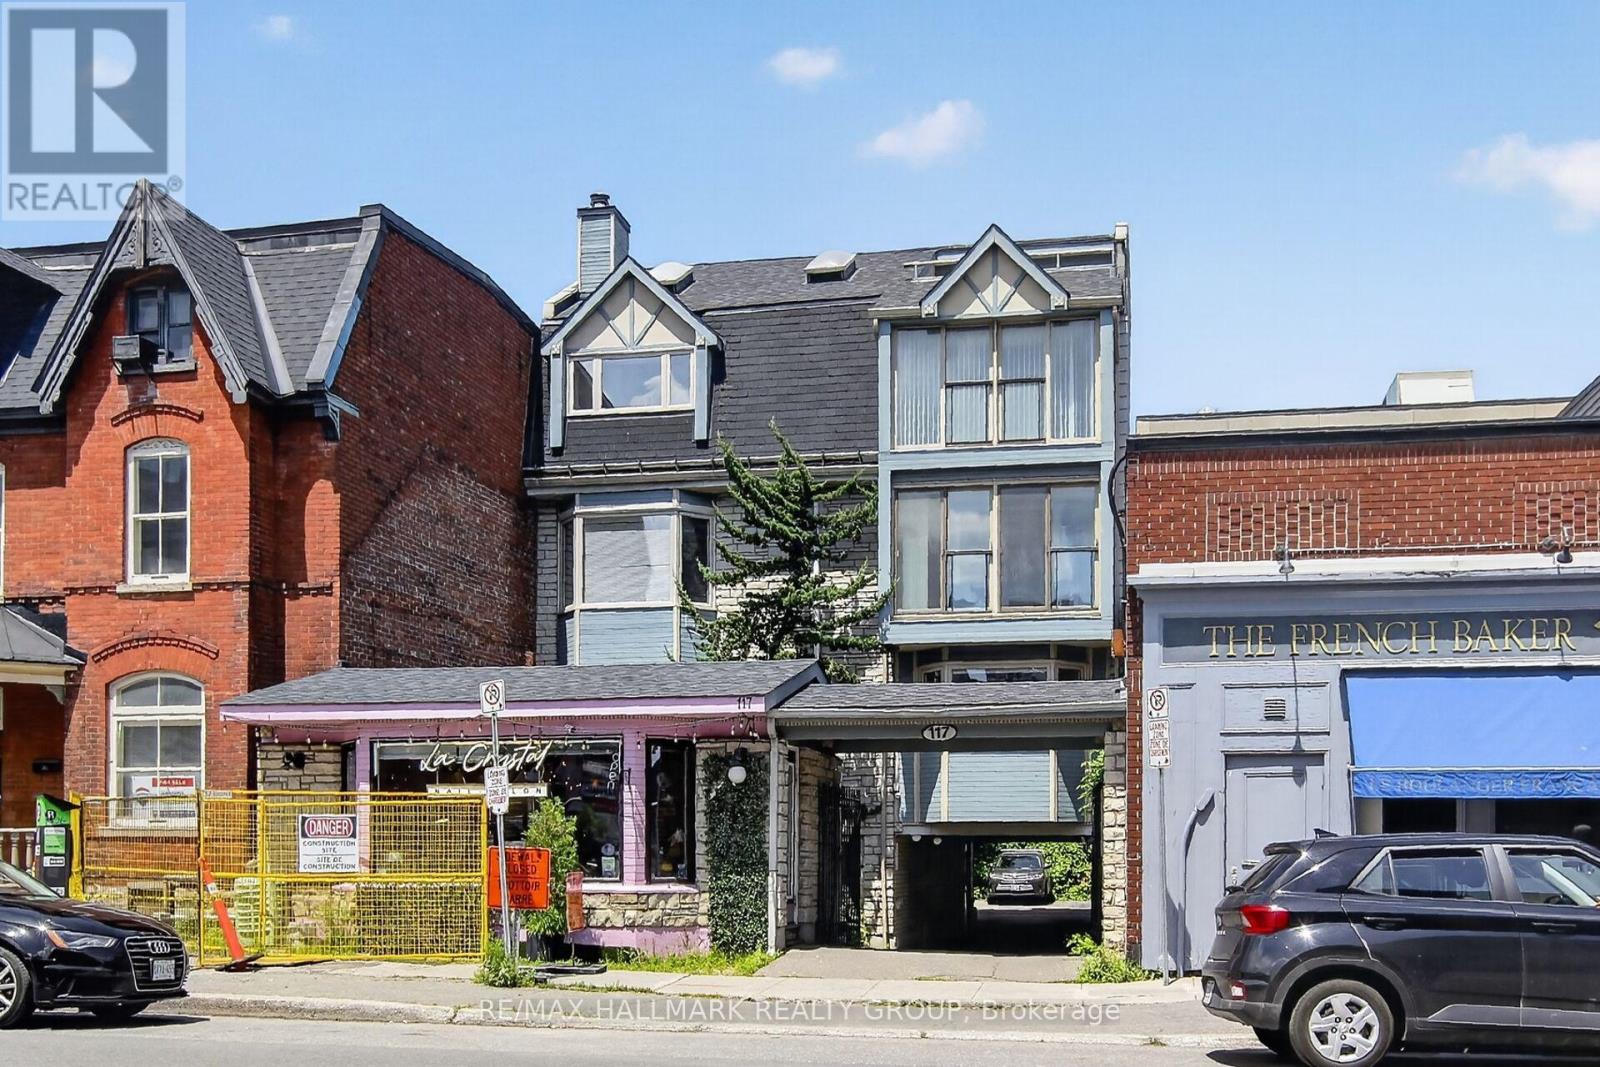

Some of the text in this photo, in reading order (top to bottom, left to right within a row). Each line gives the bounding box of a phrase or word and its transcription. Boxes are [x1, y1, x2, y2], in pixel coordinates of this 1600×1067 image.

[1203, 617, 1577, 658] THE FRENCH BAKER
[736, 697, 752, 710] 117
[928, 727, 950, 739] 117
[420, 743, 455, 772] La
[309, 819, 349, 835] DANGER
[507, 864, 537, 875] LOSED
[499, 879, 540, 891] OTTOIR
